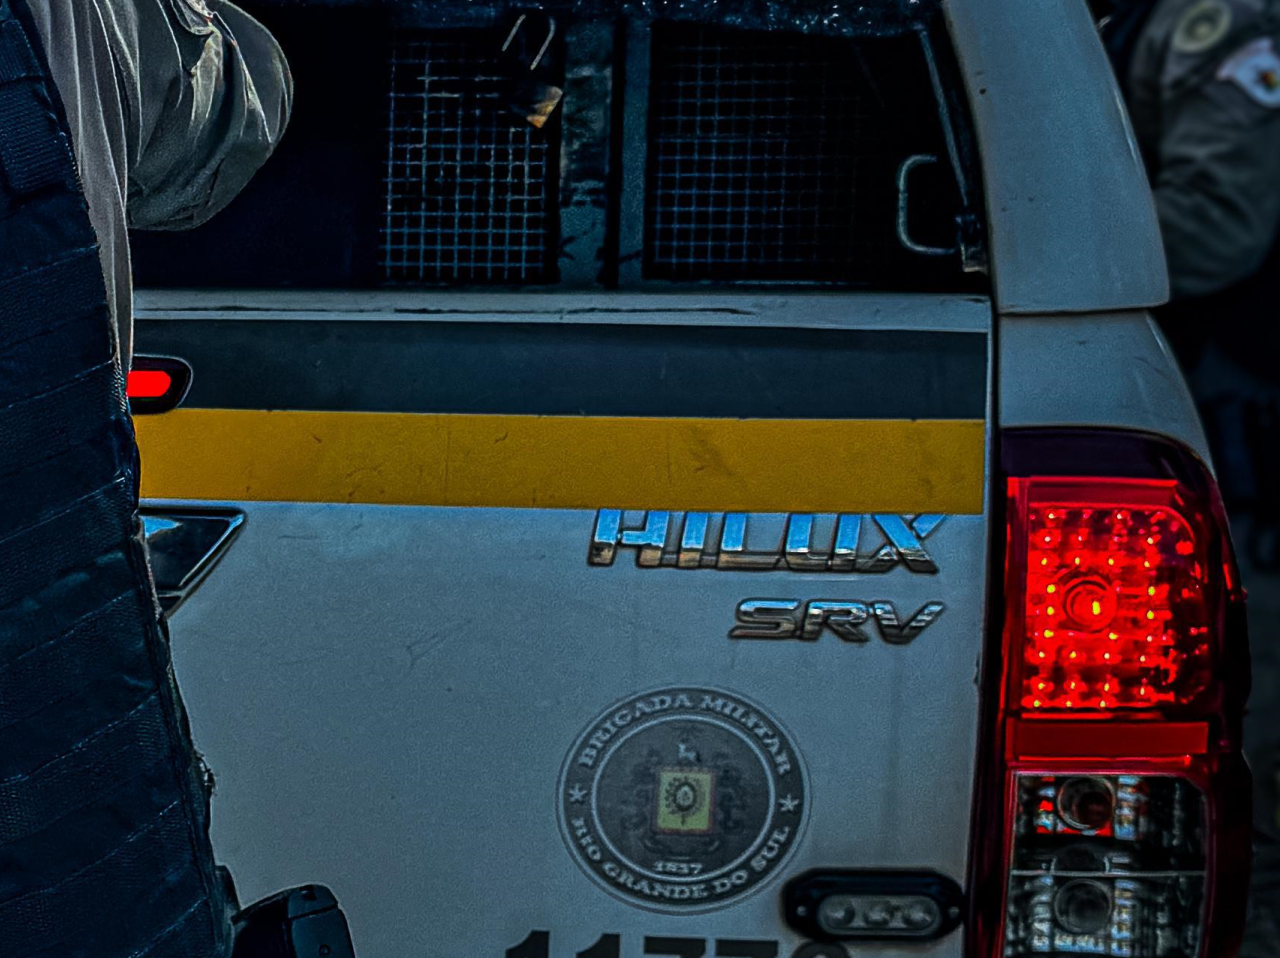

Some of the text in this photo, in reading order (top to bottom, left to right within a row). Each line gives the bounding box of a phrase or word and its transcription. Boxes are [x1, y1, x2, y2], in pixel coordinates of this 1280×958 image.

[587, 509, 947, 574] HILUX
[728, 597, 947, 645] SRV
[578, 694, 792, 776] BRIGADA MILITAR
[571, 817, 791, 899] RIO GRANDE DO SUL
